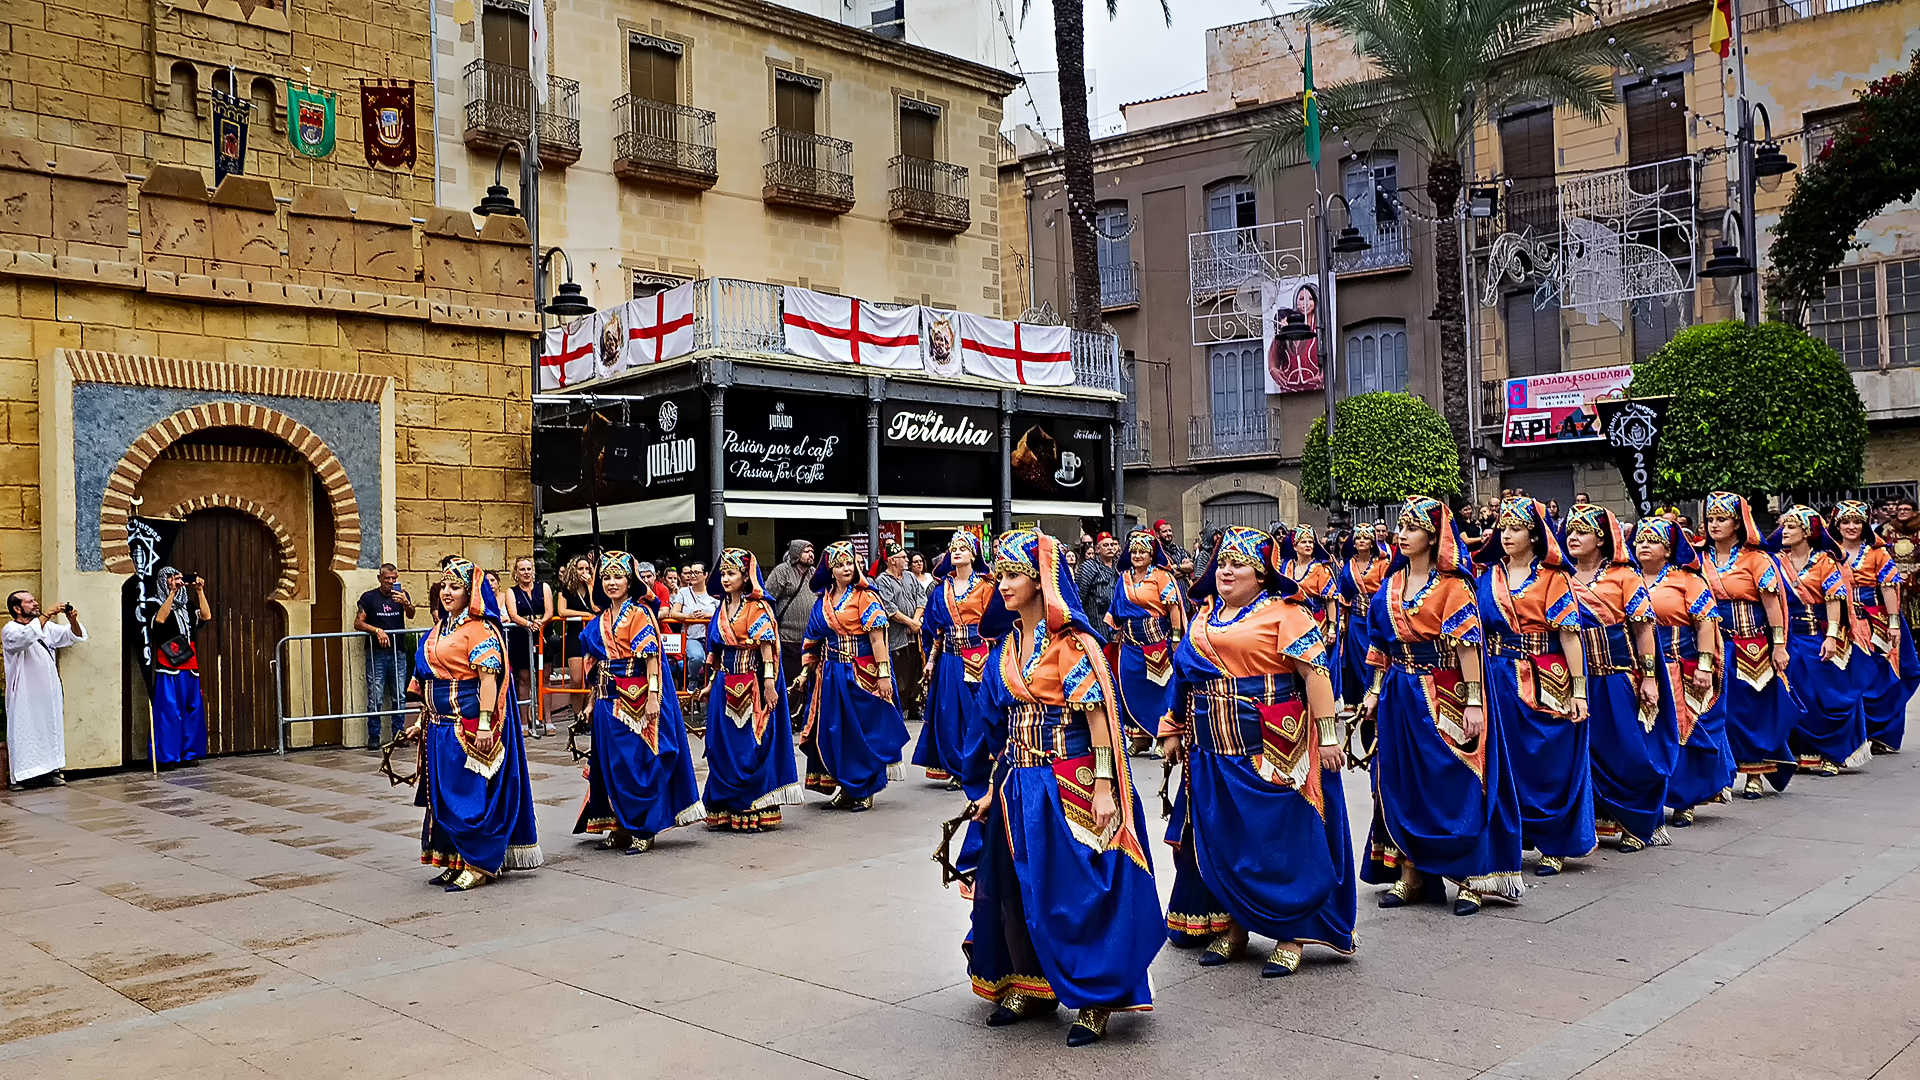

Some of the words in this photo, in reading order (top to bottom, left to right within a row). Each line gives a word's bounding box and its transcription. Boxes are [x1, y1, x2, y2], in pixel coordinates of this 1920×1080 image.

[1533, 375, 1571, 387] BAJADA
[1579, 369, 1632, 381] SOLIDARIA
[769, 414, 793, 430] JURADO
[887, 411, 993, 446] Tertulia
[915, 409, 936, 425] café
[722, 429, 766, 454] Pasión
[760, 443, 791, 462] por
[793, 435, 809, 455] el
[807, 435, 839, 462] café
[645, 437, 695, 487] JURADO
[730, 460, 773, 478] Passion
[771, 462, 790, 483] for
[790, 463, 825, 483] Coffee
[1633, 452, 1651, 515] 2019
